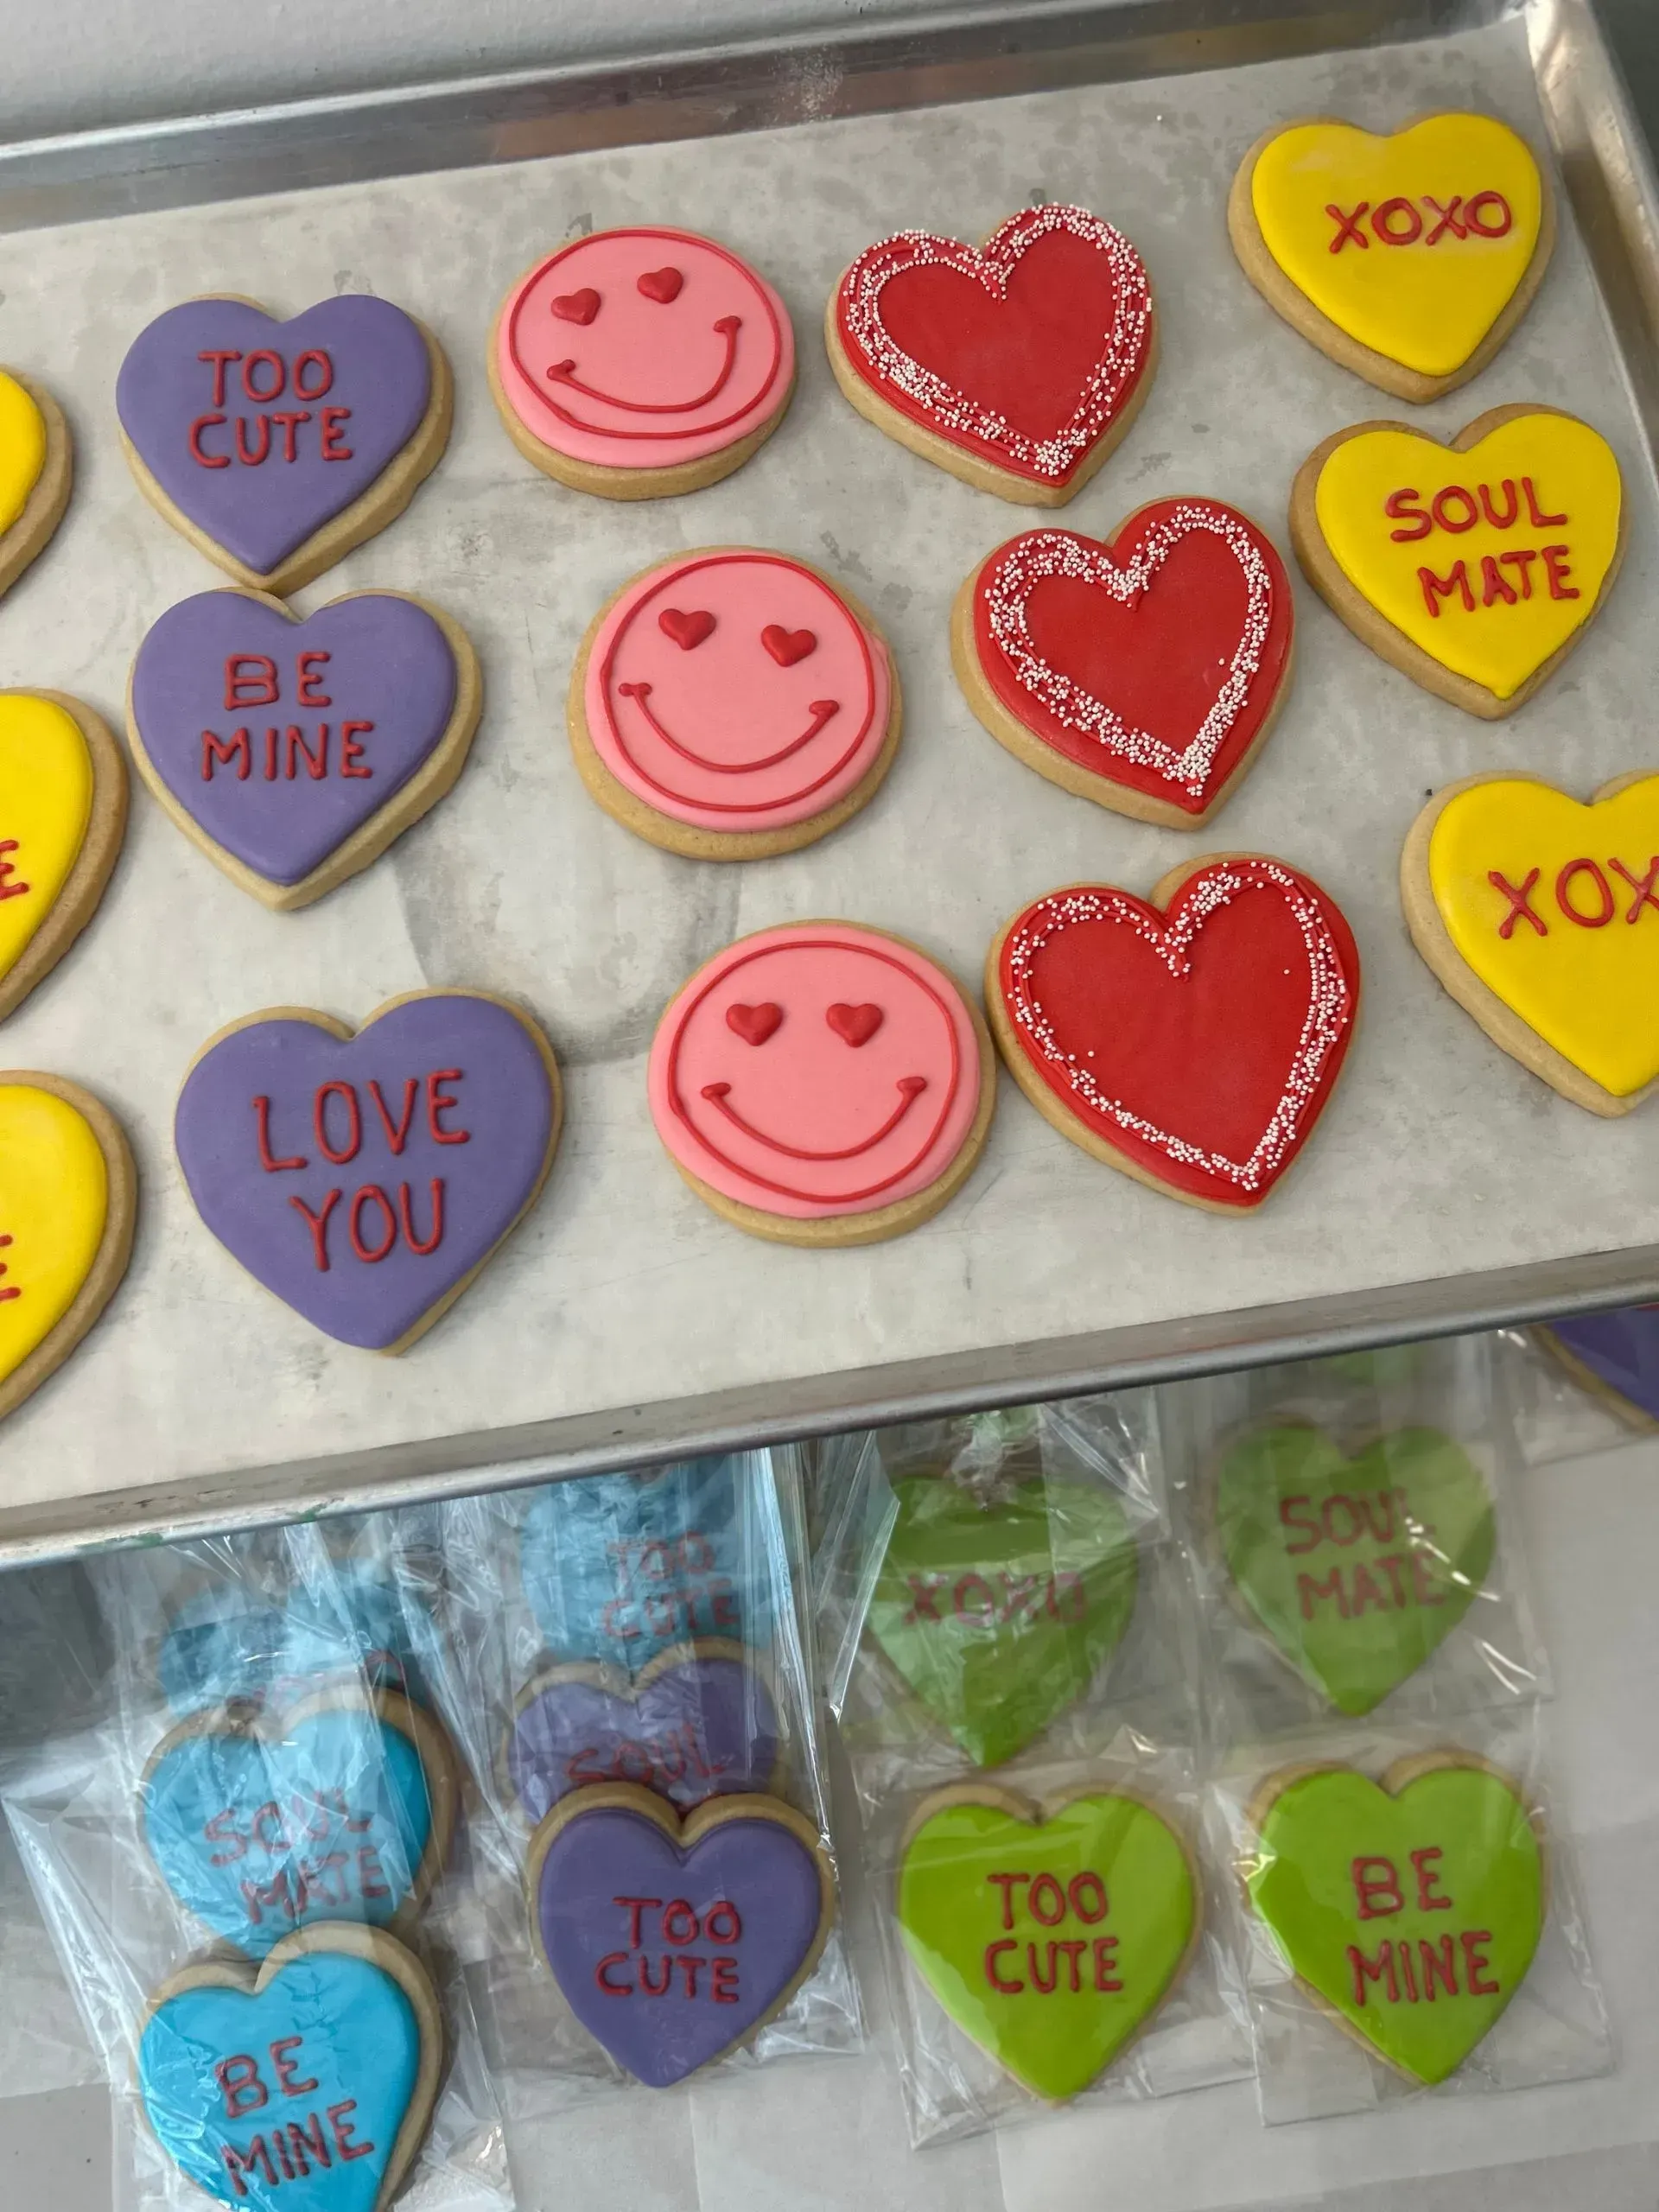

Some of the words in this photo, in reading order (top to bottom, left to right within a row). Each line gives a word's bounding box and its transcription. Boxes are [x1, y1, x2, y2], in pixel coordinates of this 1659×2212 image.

[1325, 190, 1512, 254] XOXO
[198, 349, 334, 407] TOO
[188, 407, 353, 468] CUTE
[1384, 476, 1568, 543] SOUL
[1417, 545, 1580, 618] MATE
[223, 652, 332, 711] BE
[200, 721, 374, 781] MINE
[252, 1068, 471, 1172] LOVE
[289, 1178, 445, 1272] YOU
[601, 1577, 740, 1637] CUTE
[1297, 1549, 1446, 1621] MATE
[987, 1872, 1109, 1930] TOO
[1351, 1847, 1452, 1920] BE
[612, 1896, 742, 1949] TOO
[594, 1952, 740, 2003] CUTE
[984, 1936, 1123, 1994] CUTE
[1345, 1930, 1500, 2007] MINE
[214, 2036, 320, 2119] BE
[219, 2099, 376, 2196] MINE
